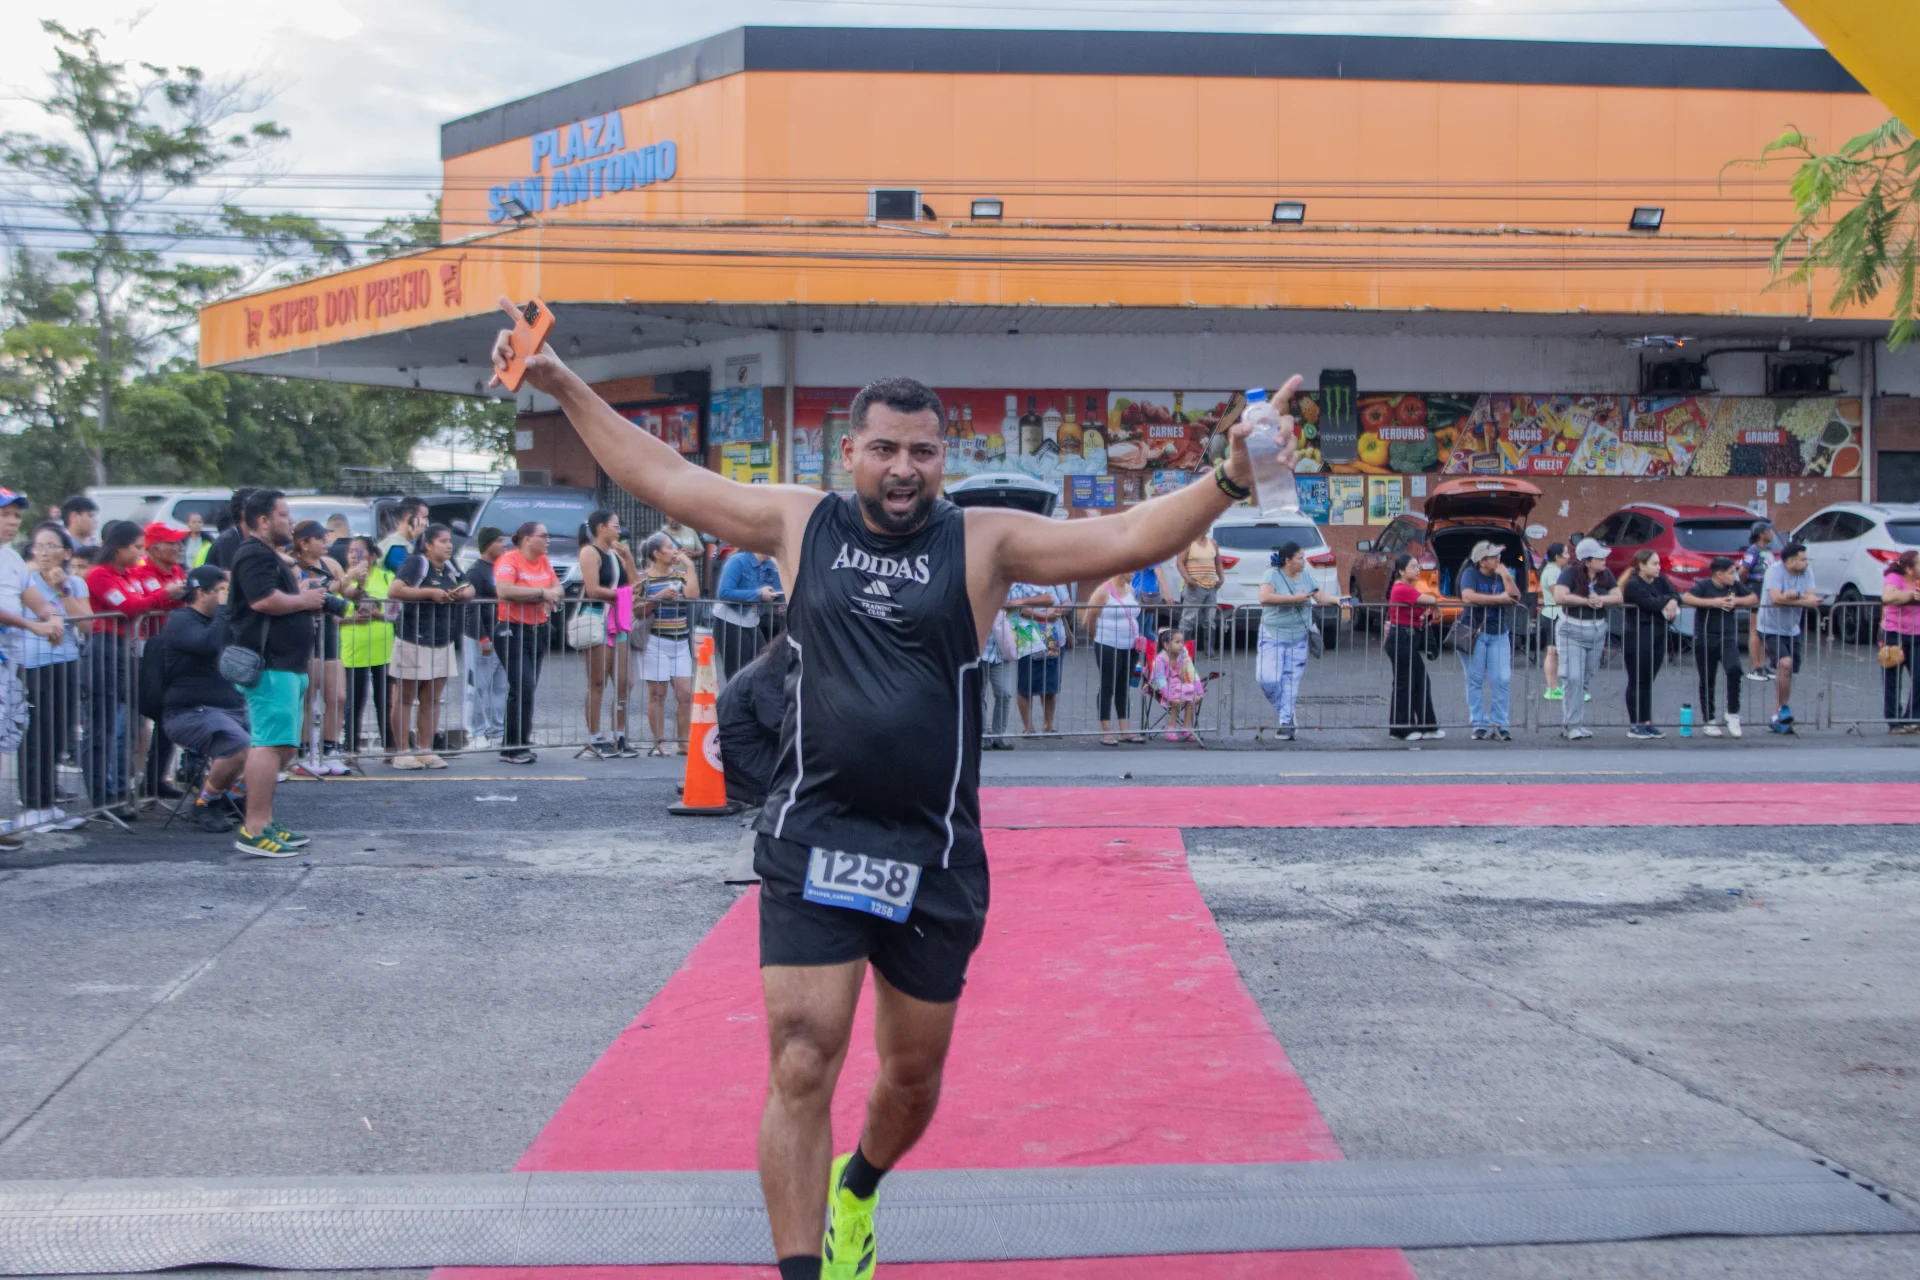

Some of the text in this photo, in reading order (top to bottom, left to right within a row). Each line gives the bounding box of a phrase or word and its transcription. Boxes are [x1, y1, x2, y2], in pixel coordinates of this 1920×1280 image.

[532, 111, 626, 173] PLAZA
[268, 267, 432, 339] SUPER DON PRECIO
[1149, 426, 1185, 439] CARNES
[1379, 427, 1426, 440] VERDURAS
[1507, 429, 1543, 441] SNACKS
[1622, 430, 1665, 443] CEREALES
[1745, 431, 1780, 444] GRANOS
[1534, 459, 1555, 470] CHEEZ
[830, 543, 930, 585] ADIDAS
[861, 602, 892, 613] TRAINING
[867, 608, 886, 617] CLUB
[821, 851, 909, 899] 1258
[871, 900, 894, 918] 1258
